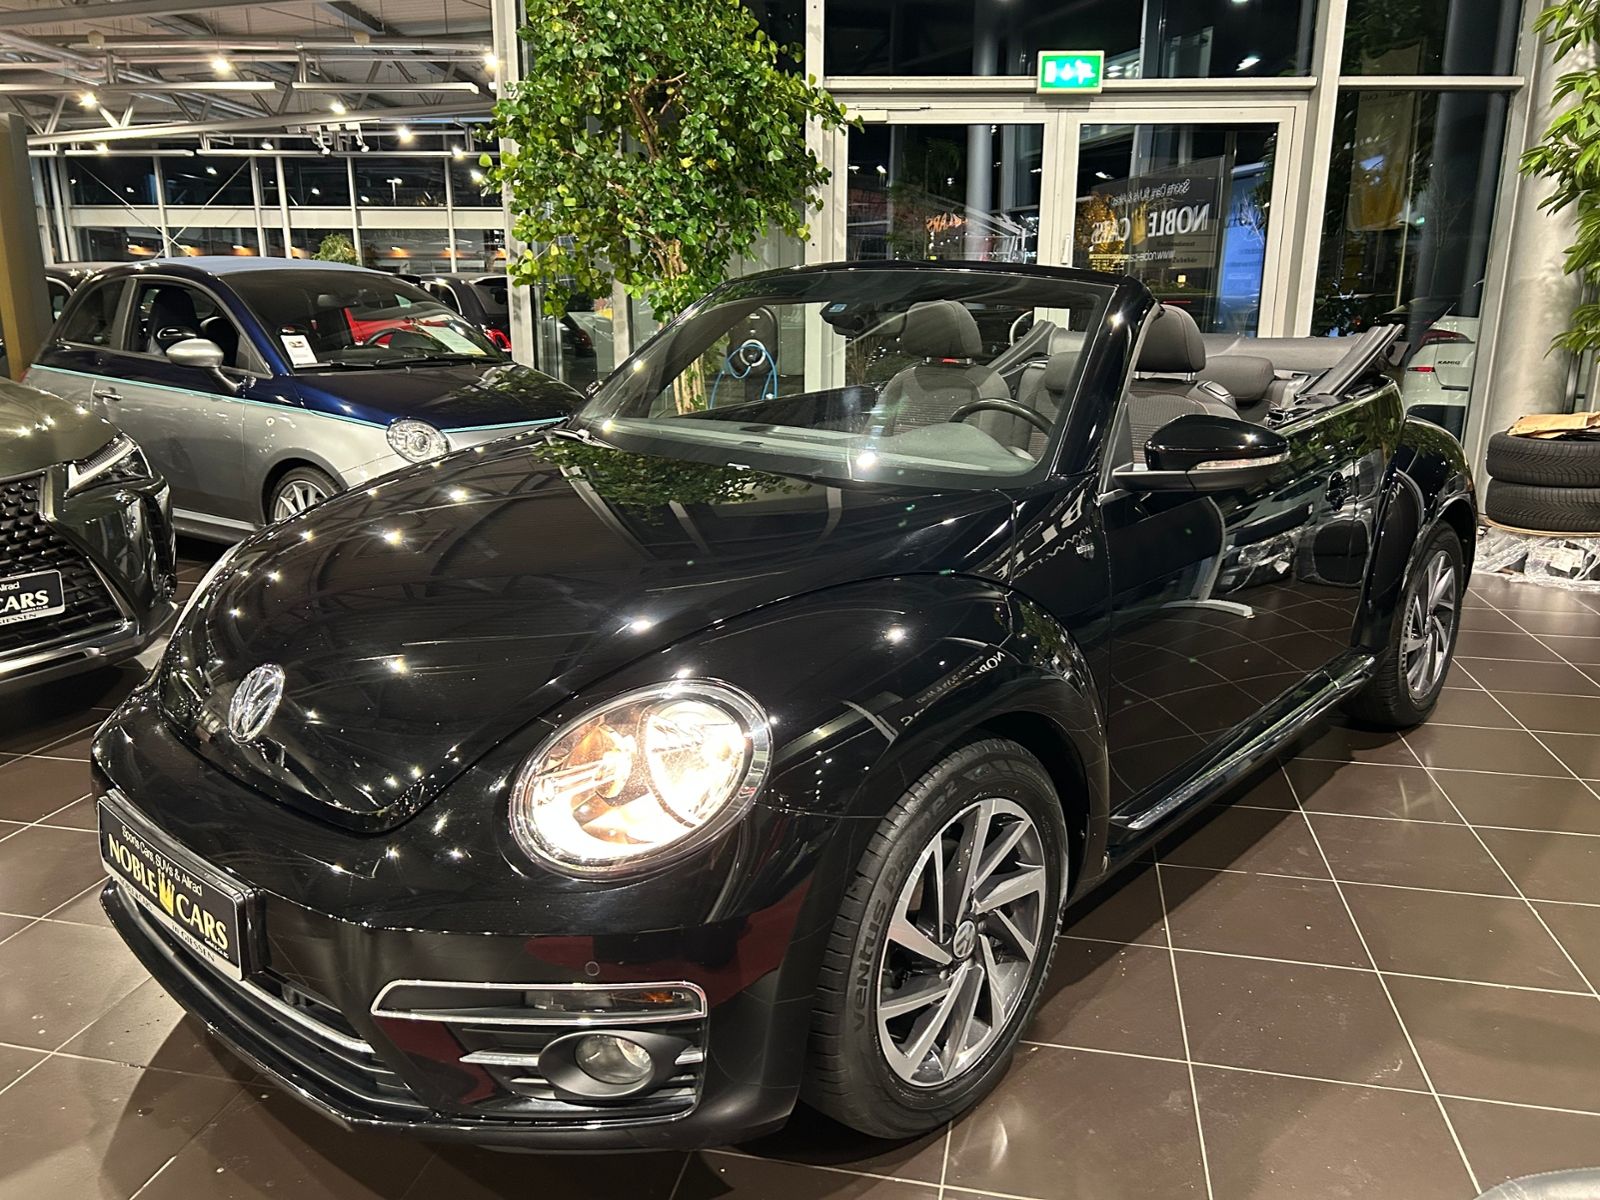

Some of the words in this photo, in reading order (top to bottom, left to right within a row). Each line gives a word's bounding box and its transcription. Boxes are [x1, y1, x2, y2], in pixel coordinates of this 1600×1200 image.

[122, 825, 140, 850] Sports
[108, 833, 158, 898] NOBLE
[176, 893, 228, 950] CARS
